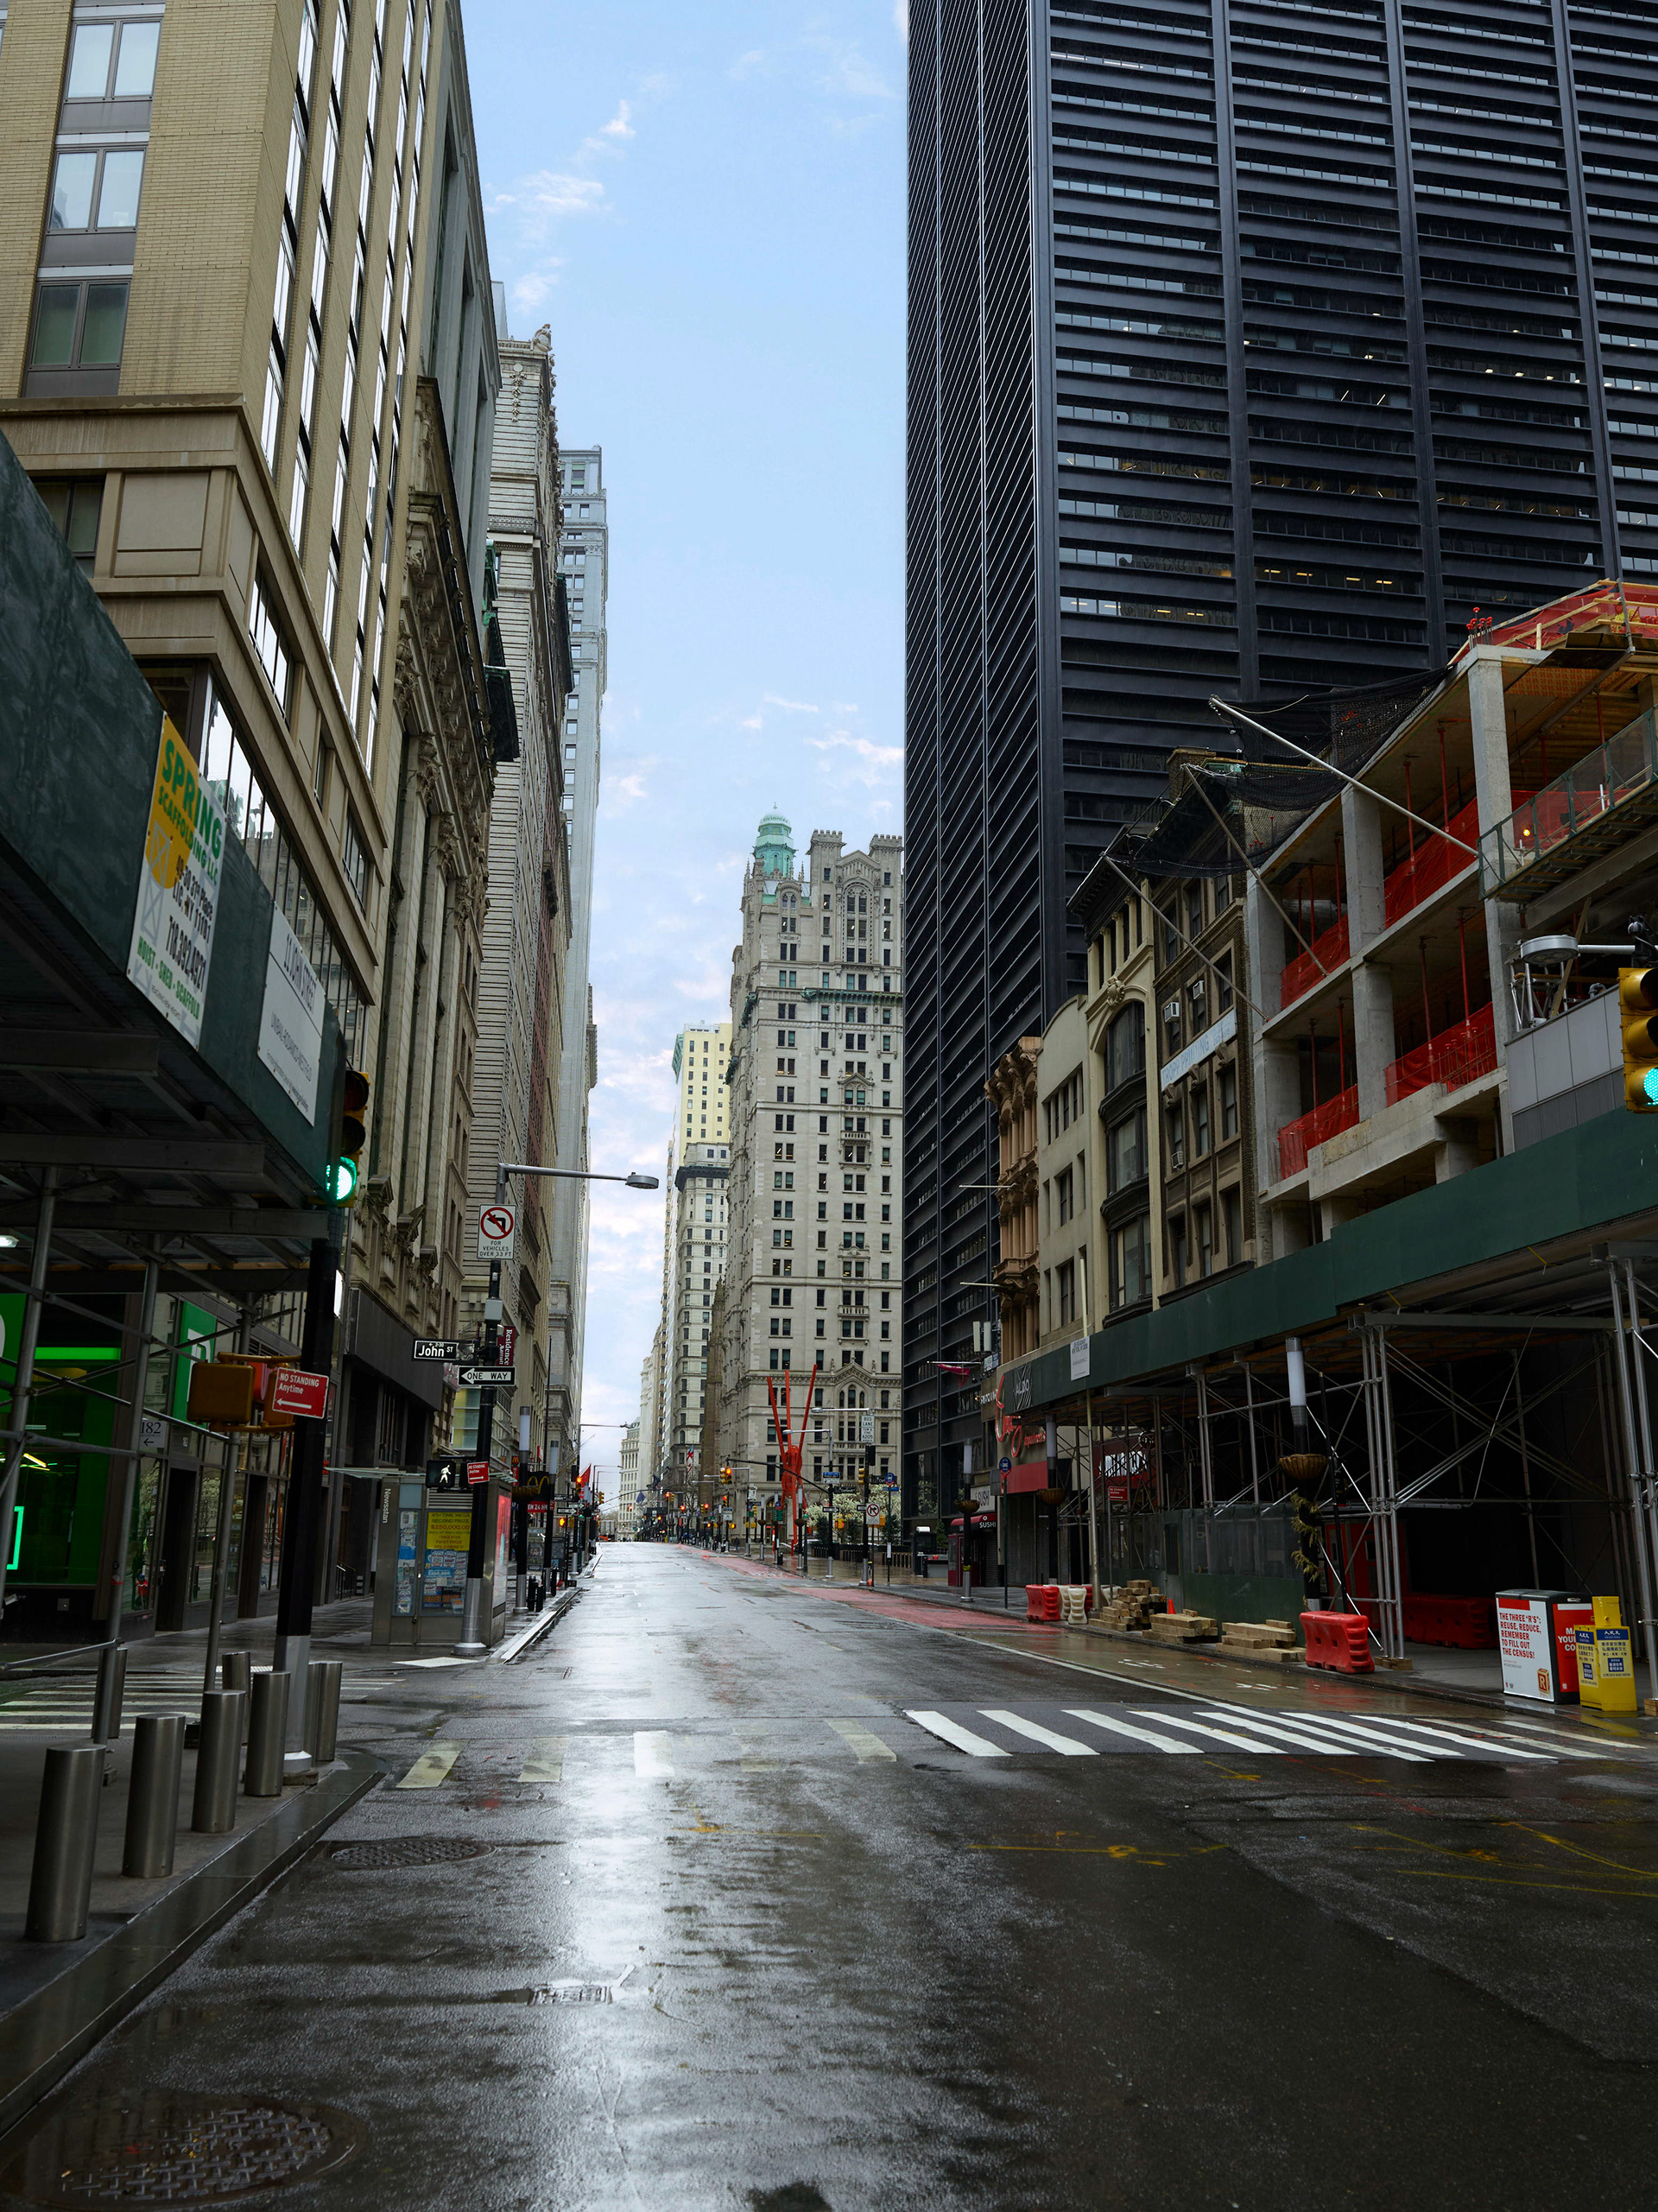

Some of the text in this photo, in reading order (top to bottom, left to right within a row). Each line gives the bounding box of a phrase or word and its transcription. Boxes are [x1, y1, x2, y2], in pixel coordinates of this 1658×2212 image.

[161, 738, 223, 859] SPRING
[157, 785, 218, 886] SCAFFOLDING LLC
[184, 895, 194, 922] NY
[194, 908, 211, 944] 11101
[199, 887, 213, 922] Place
[166, 915, 206, 992] 718.392.4921
[283, 933, 292, 973] 11
[136, 935, 200, 1020] HOIST SHED SCAFFOLD
[1180, 1034, 1209, 1071] PRINTING
[418, 1345, 445, 1358] John
[503, 1329, 513, 1366] Residence
[279, 1383, 304, 1395] Anytime
[280, 1372, 320, 1387] NO STANDING
[141, 1422, 161, 1434] 182
[1500, 1621, 1541, 1634] REUSE, REDUCE,
[1501, 1630, 1530, 1640] REMEMBER
[1503, 1647, 1535, 1658] THE CENSUS!
[1540, 1675, 1546, 1689] R
